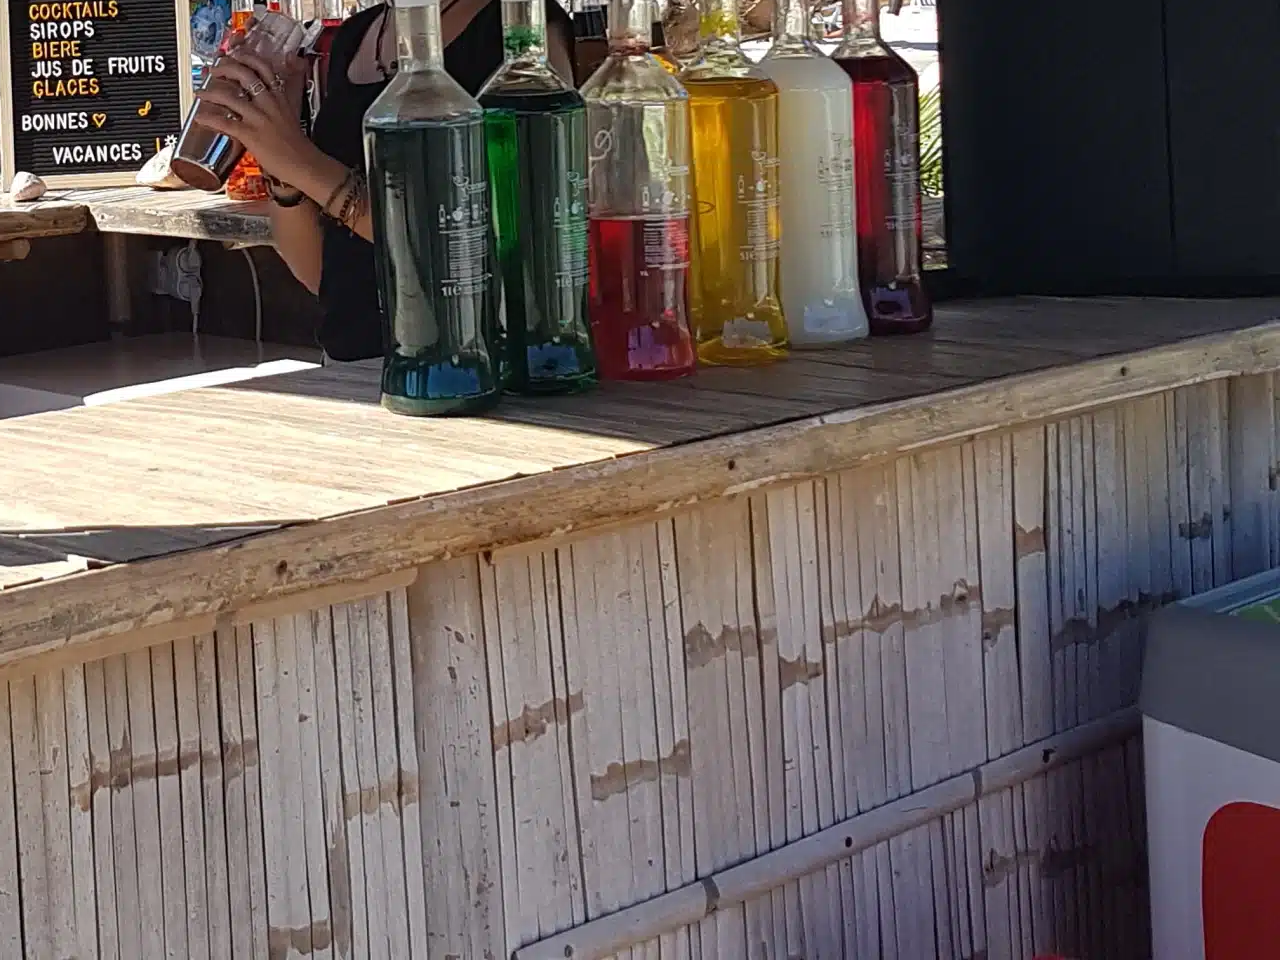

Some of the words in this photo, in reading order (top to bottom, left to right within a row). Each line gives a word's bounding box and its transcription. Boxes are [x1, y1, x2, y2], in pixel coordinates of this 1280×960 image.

[29, 0, 118, 20] COCKTAILS
[30, 21, 94, 39] SIROPS
[33, 39, 81, 58] BIERE
[32, 61, 62, 78] JUS
[72, 59, 93, 75] DE
[108, 56, 165, 74] FRUITS
[33, 77, 99, 98] GLACES
[22, 112, 88, 131] BONNES
[53, 144, 141, 164] VACANCES
